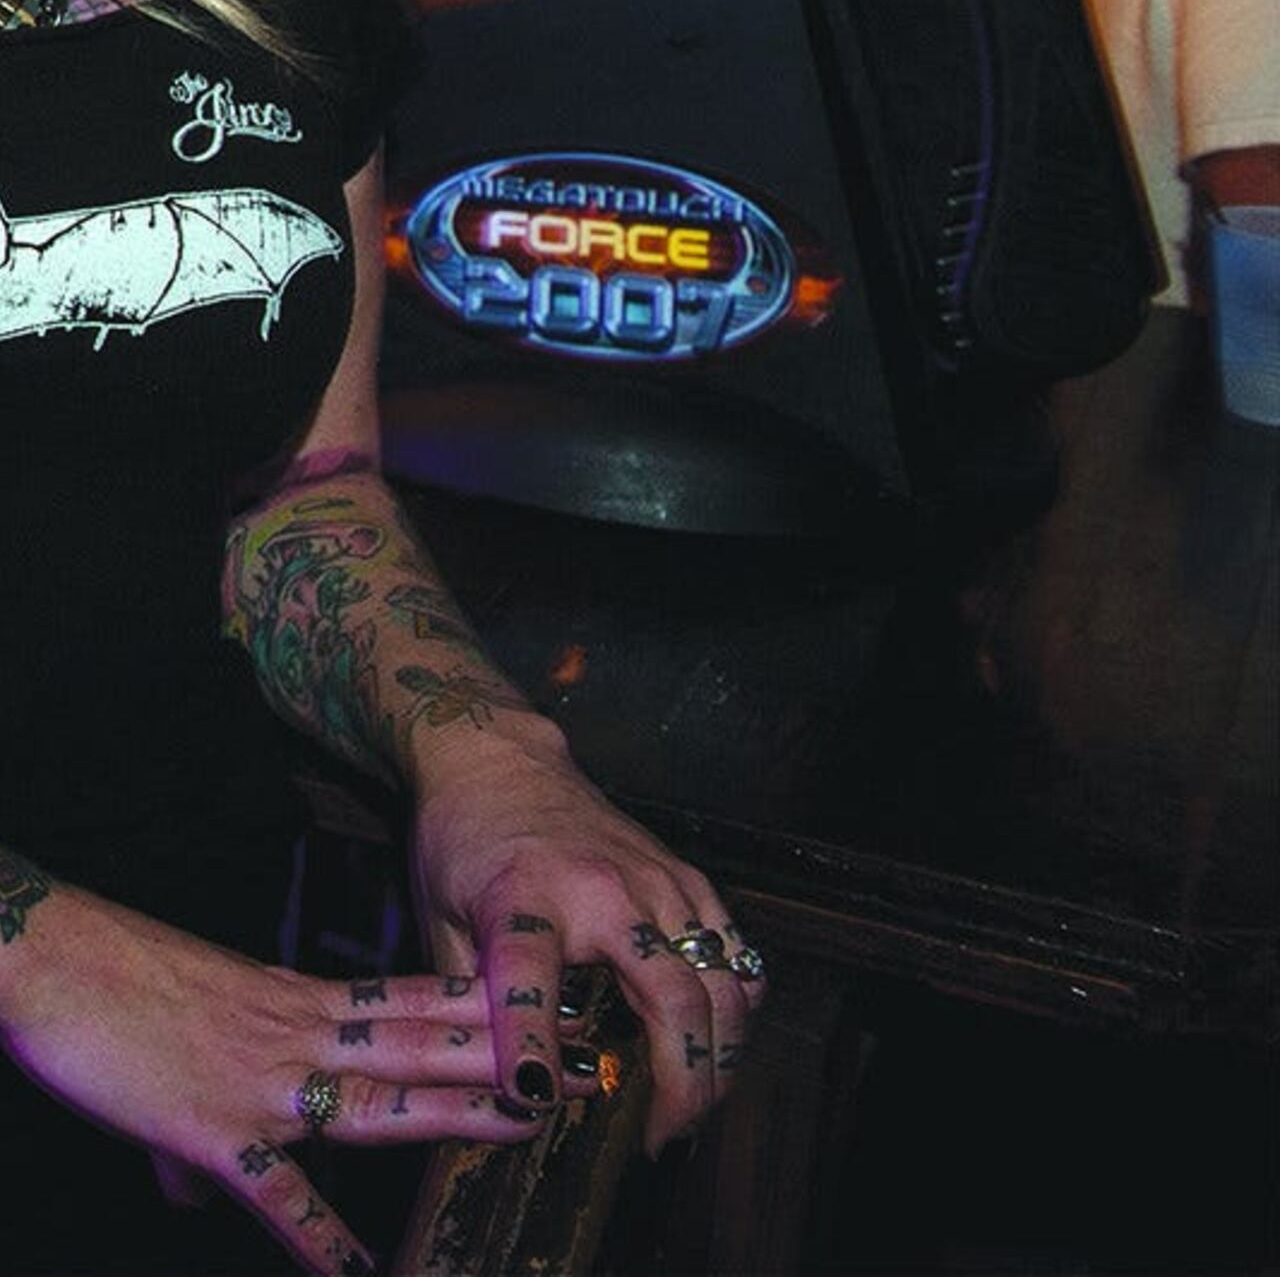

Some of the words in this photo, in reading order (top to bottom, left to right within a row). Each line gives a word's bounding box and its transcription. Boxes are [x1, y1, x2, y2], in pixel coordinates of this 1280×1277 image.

[461, 175, 745, 223] MEGATOUCH
[485, 210, 711, 270] FORCE
[463, 258, 735, 352] 2007
